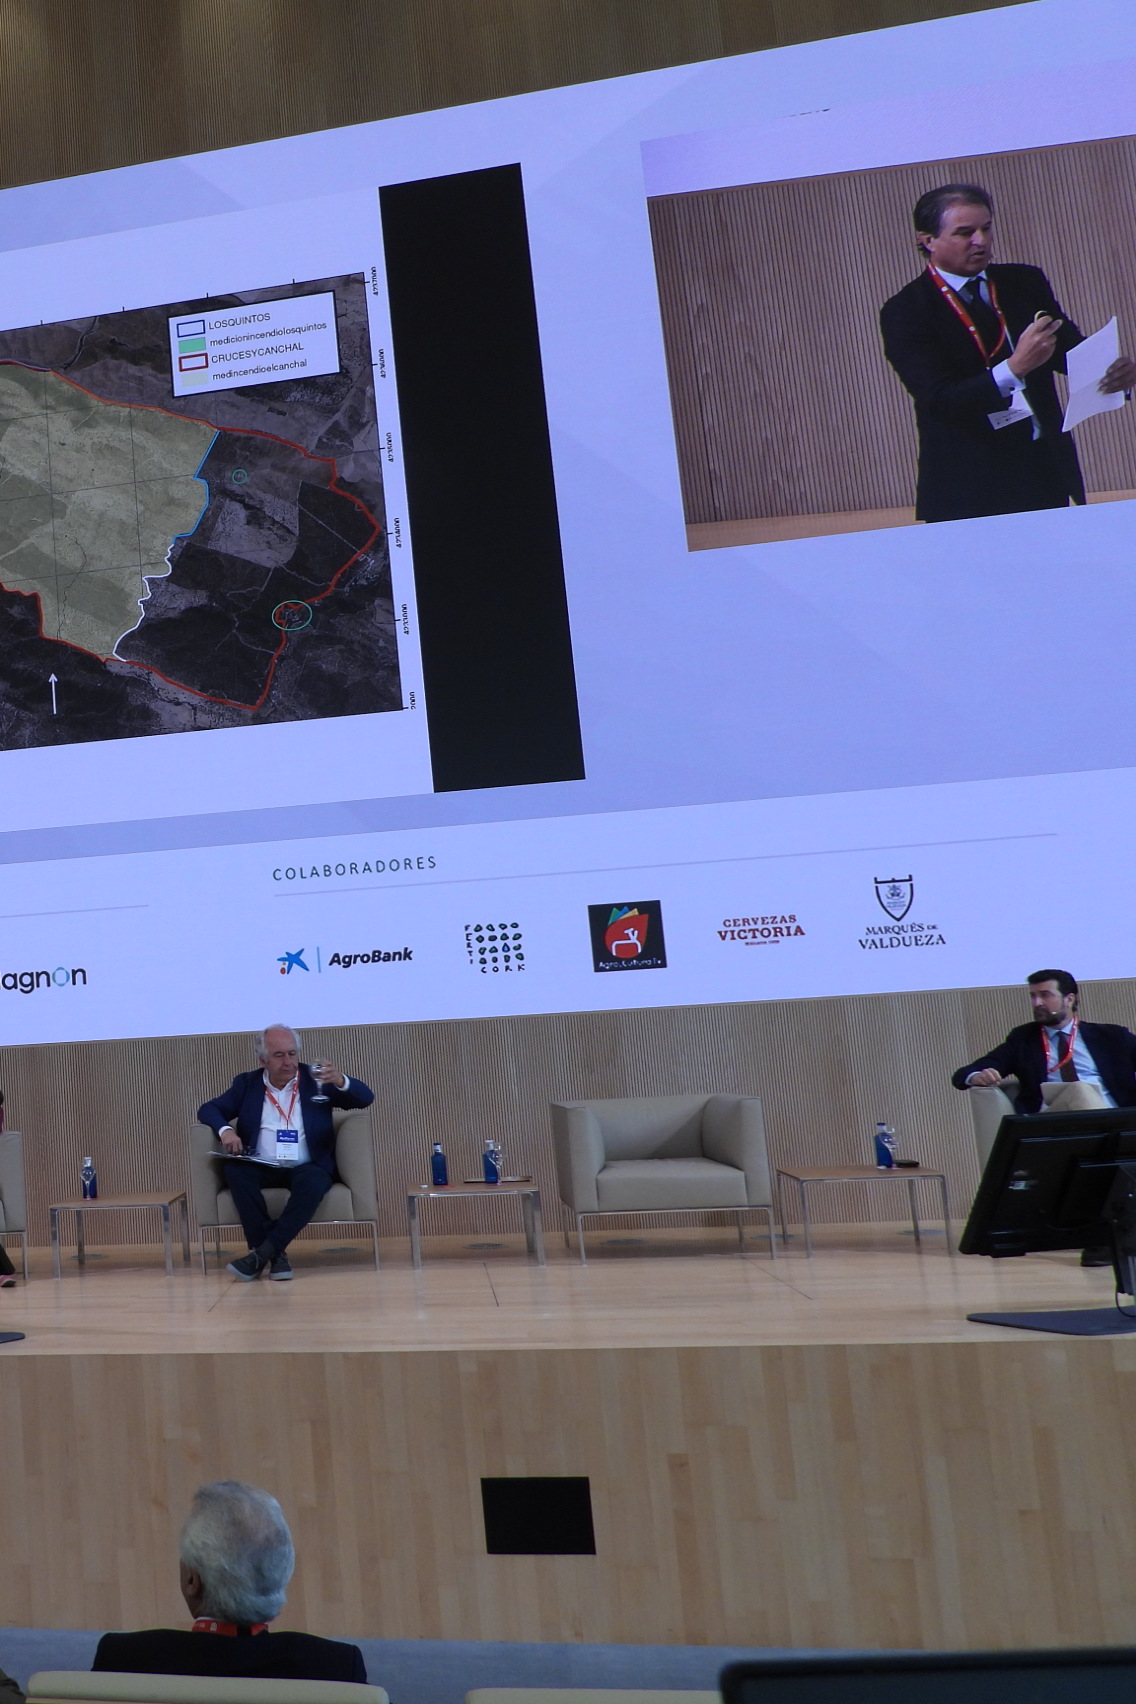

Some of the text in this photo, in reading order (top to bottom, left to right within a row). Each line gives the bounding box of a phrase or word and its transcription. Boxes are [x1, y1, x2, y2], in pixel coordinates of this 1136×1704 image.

[208, 312, 271, 330] LOSQUINTOS
[210, 322, 327, 347] medicionincendiolosquintos
[211, 342, 304, 364] CRUCESYCANCHAL
[272, 855, 437, 881] COLABORADORES
[722, 914, 797, 928] CERVEZAS
[865, 922, 925, 936] MARQUÉS
[717, 925, 806, 941] VICTORIA
[858, 933, 946, 950] VALDUEZA
[328, 947, 413, 968] AgroBank
